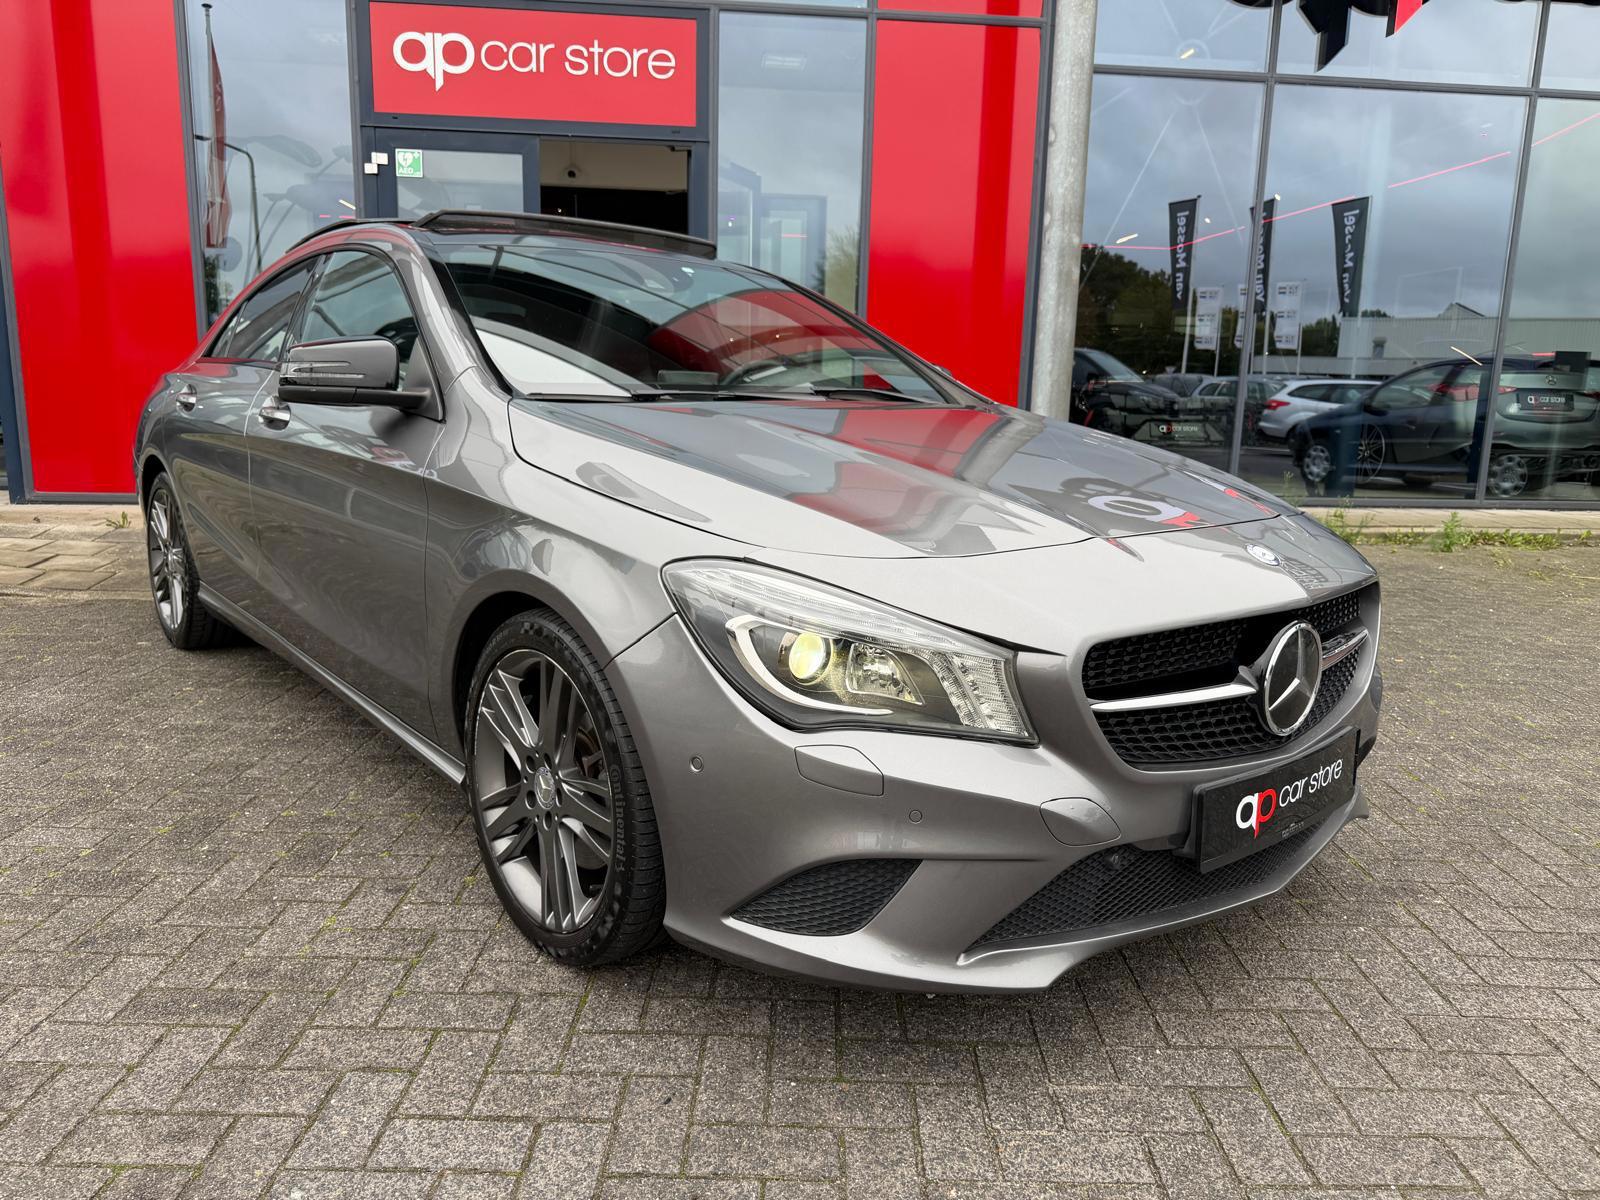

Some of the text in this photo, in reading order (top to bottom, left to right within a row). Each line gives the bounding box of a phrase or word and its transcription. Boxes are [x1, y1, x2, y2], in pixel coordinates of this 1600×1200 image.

[392, 30, 676, 92] ap car store
[398, 167, 414, 175] AED
[1235, 788, 1277, 839] ap
[1279, 777, 1309, 807] car
[1309, 759, 1343, 794] store
